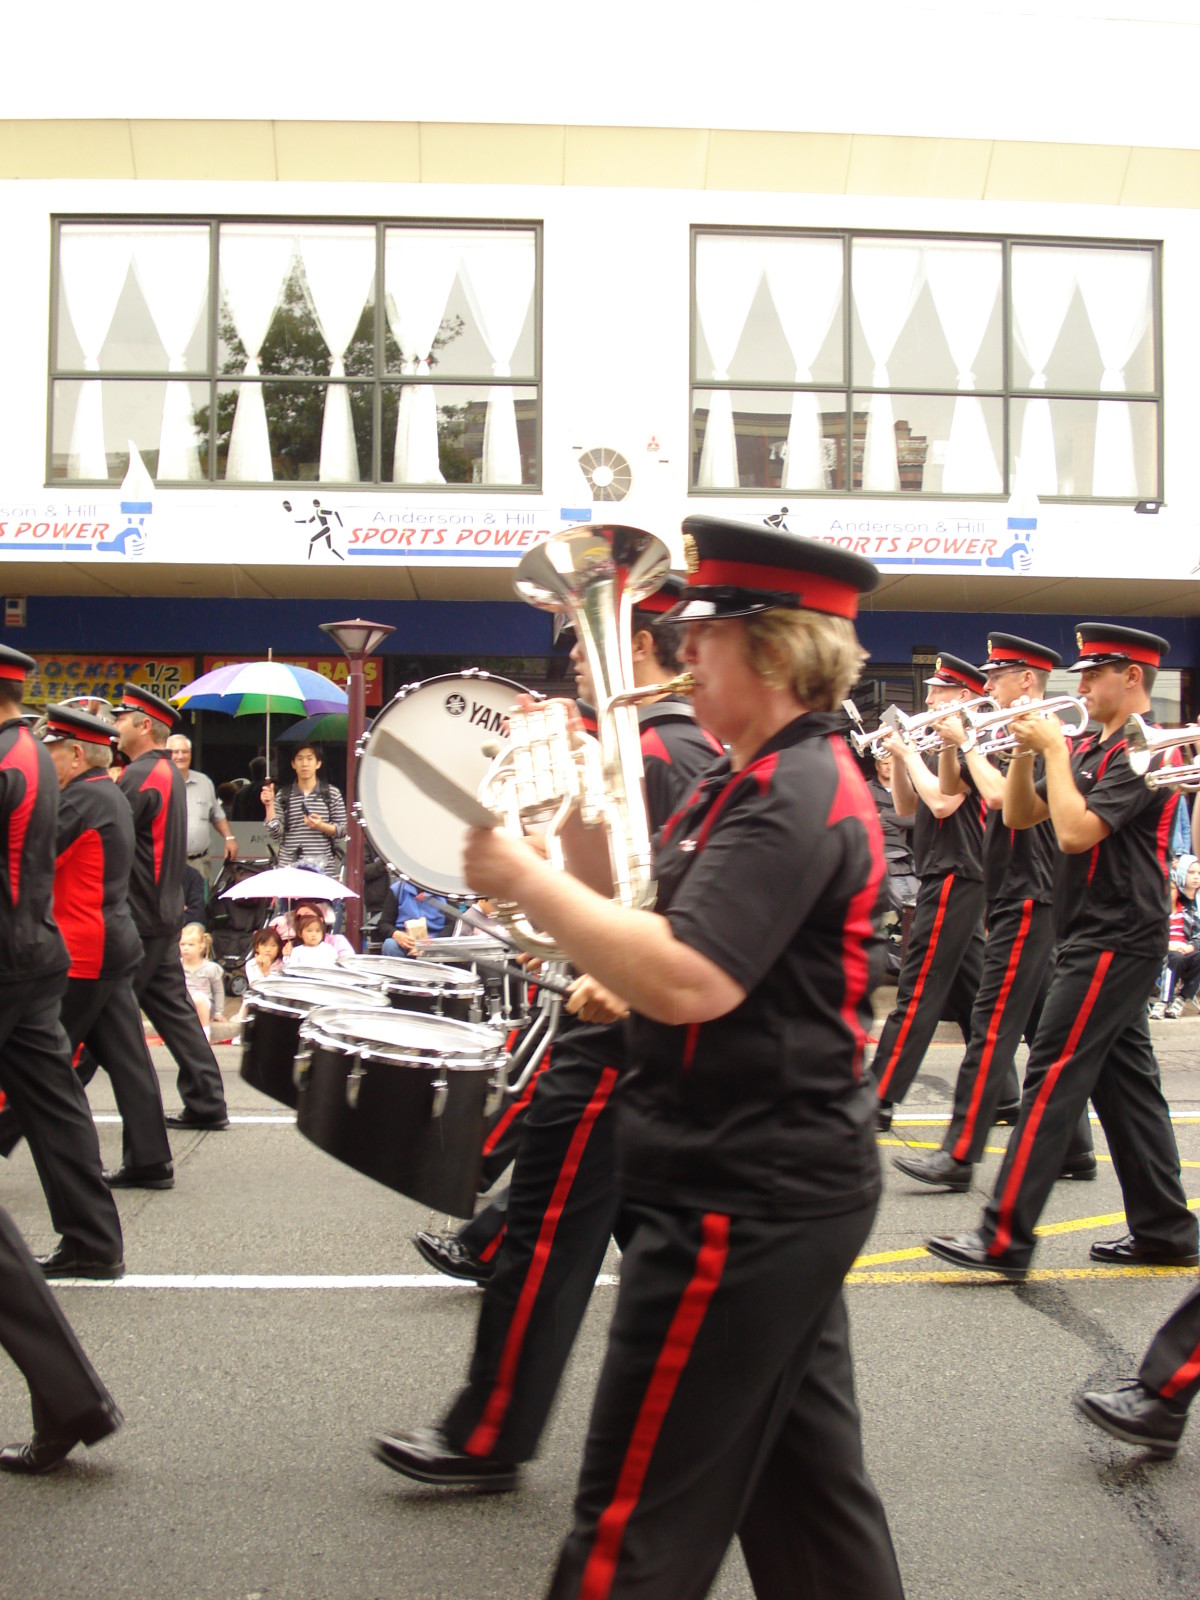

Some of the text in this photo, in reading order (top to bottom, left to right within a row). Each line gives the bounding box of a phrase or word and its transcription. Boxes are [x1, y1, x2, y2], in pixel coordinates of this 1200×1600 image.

[44, 504, 58, 518] &
[67, 503, 97, 518] Hill
[372, 511, 536, 526] Anderson & Hill
[14, 522, 110, 540] POWER
[830, 519, 985, 534] Anderson & Hill
[348, 527, 448, 546] SPORTS
[811, 535, 998, 556] ORTS POWER
[144, 662, 180, 682] 1/2
[317, 661, 378, 681] BAS
[141, 683, 187, 699] RIC
[468, 701, 511, 739] YAM
